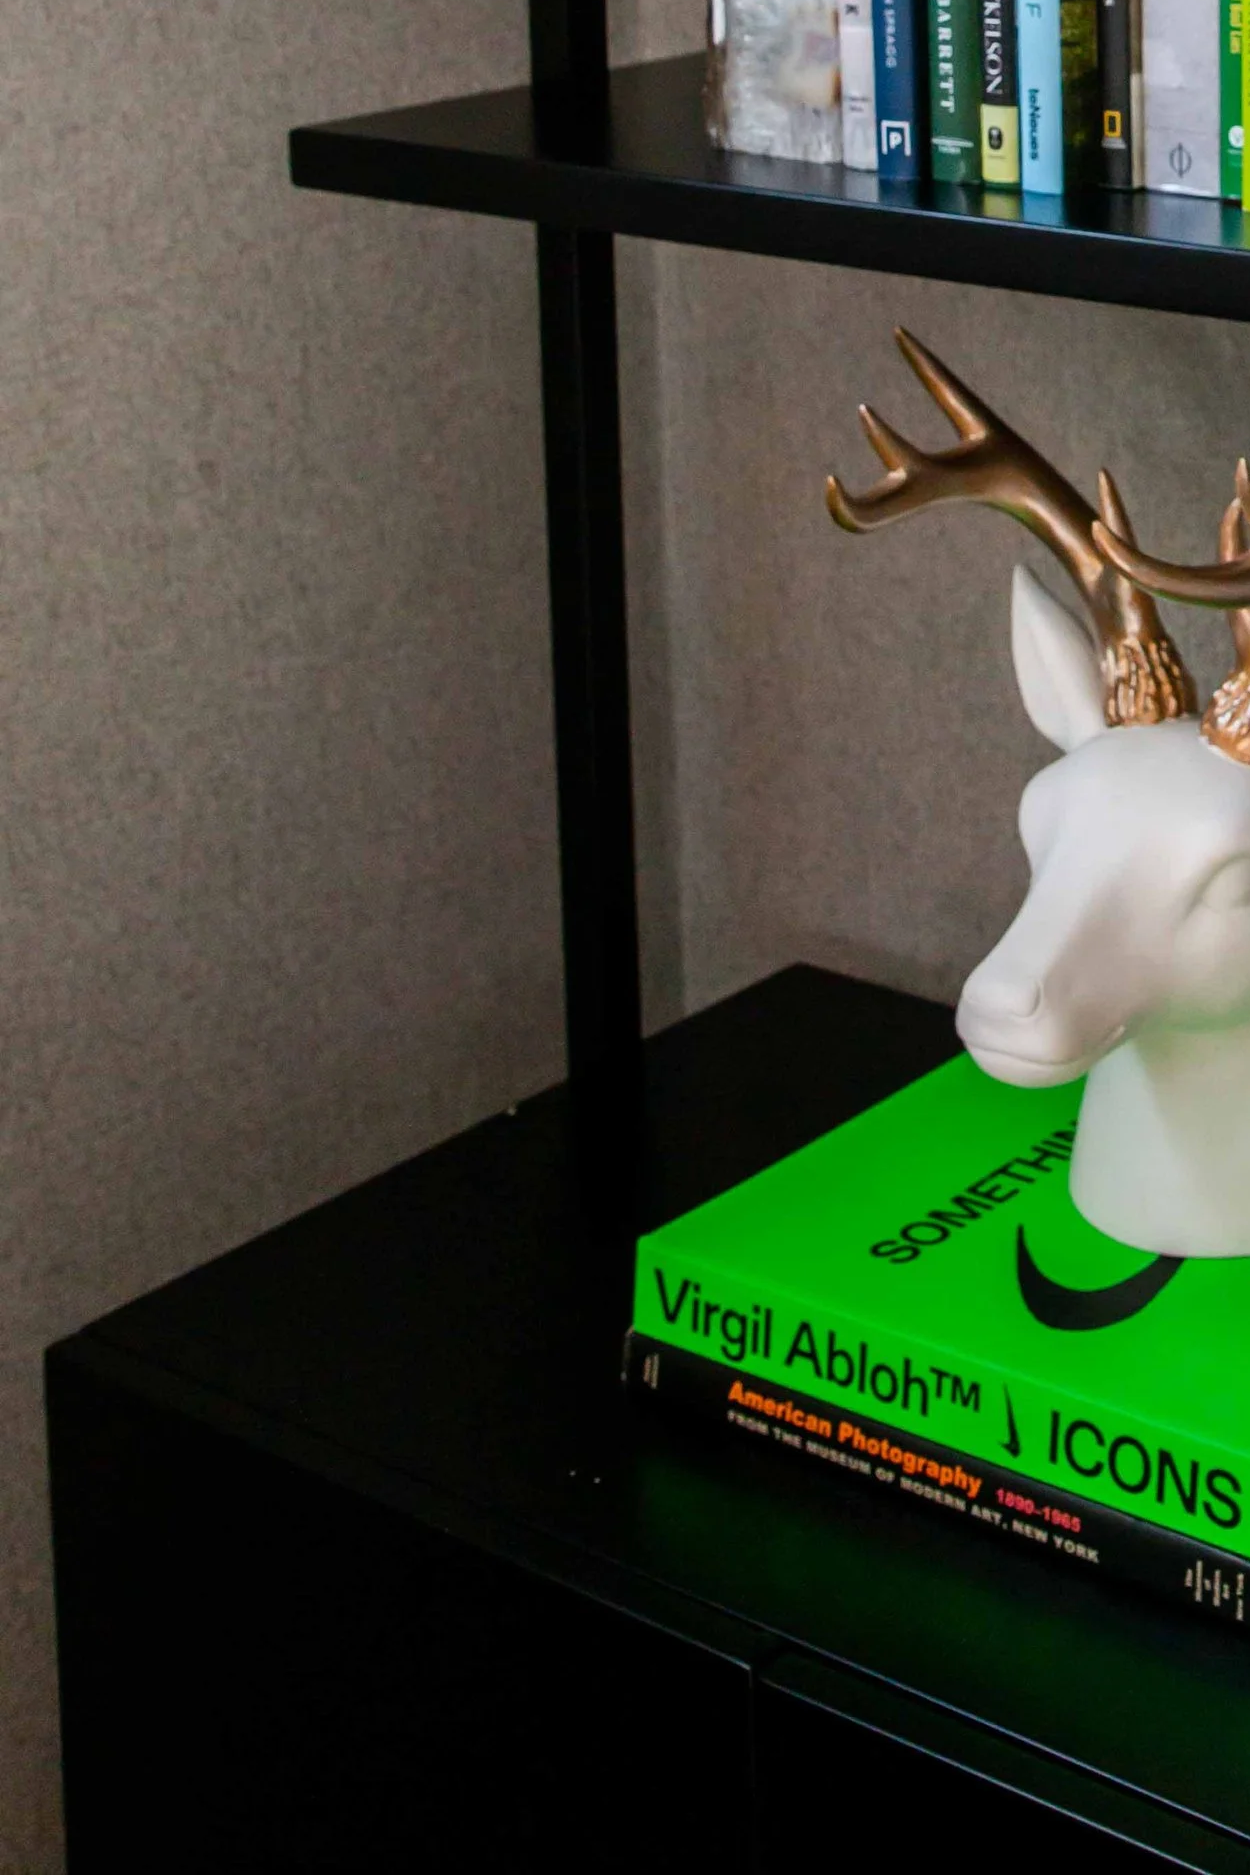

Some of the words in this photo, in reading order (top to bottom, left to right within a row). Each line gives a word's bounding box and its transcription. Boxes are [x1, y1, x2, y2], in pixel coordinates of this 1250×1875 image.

[653, 1266, 773, 1363] Virgil
[1047, 1409, 1243, 1530] ICONS
[727, 1380, 832, 1437] American
[837, 1421, 983, 1499] Photography
[727, 1409, 769, 1438] FROM
[774, 1427, 803, 1450] THE
[805, 1439, 872, 1476] MUSEUM
[875, 1465, 896, 1485] OF
[900, 1476, 967, 1514] MODERN
[1011, 1518, 1049, 1544] NEW
[1052, 1535, 1100, 1565] YORK
